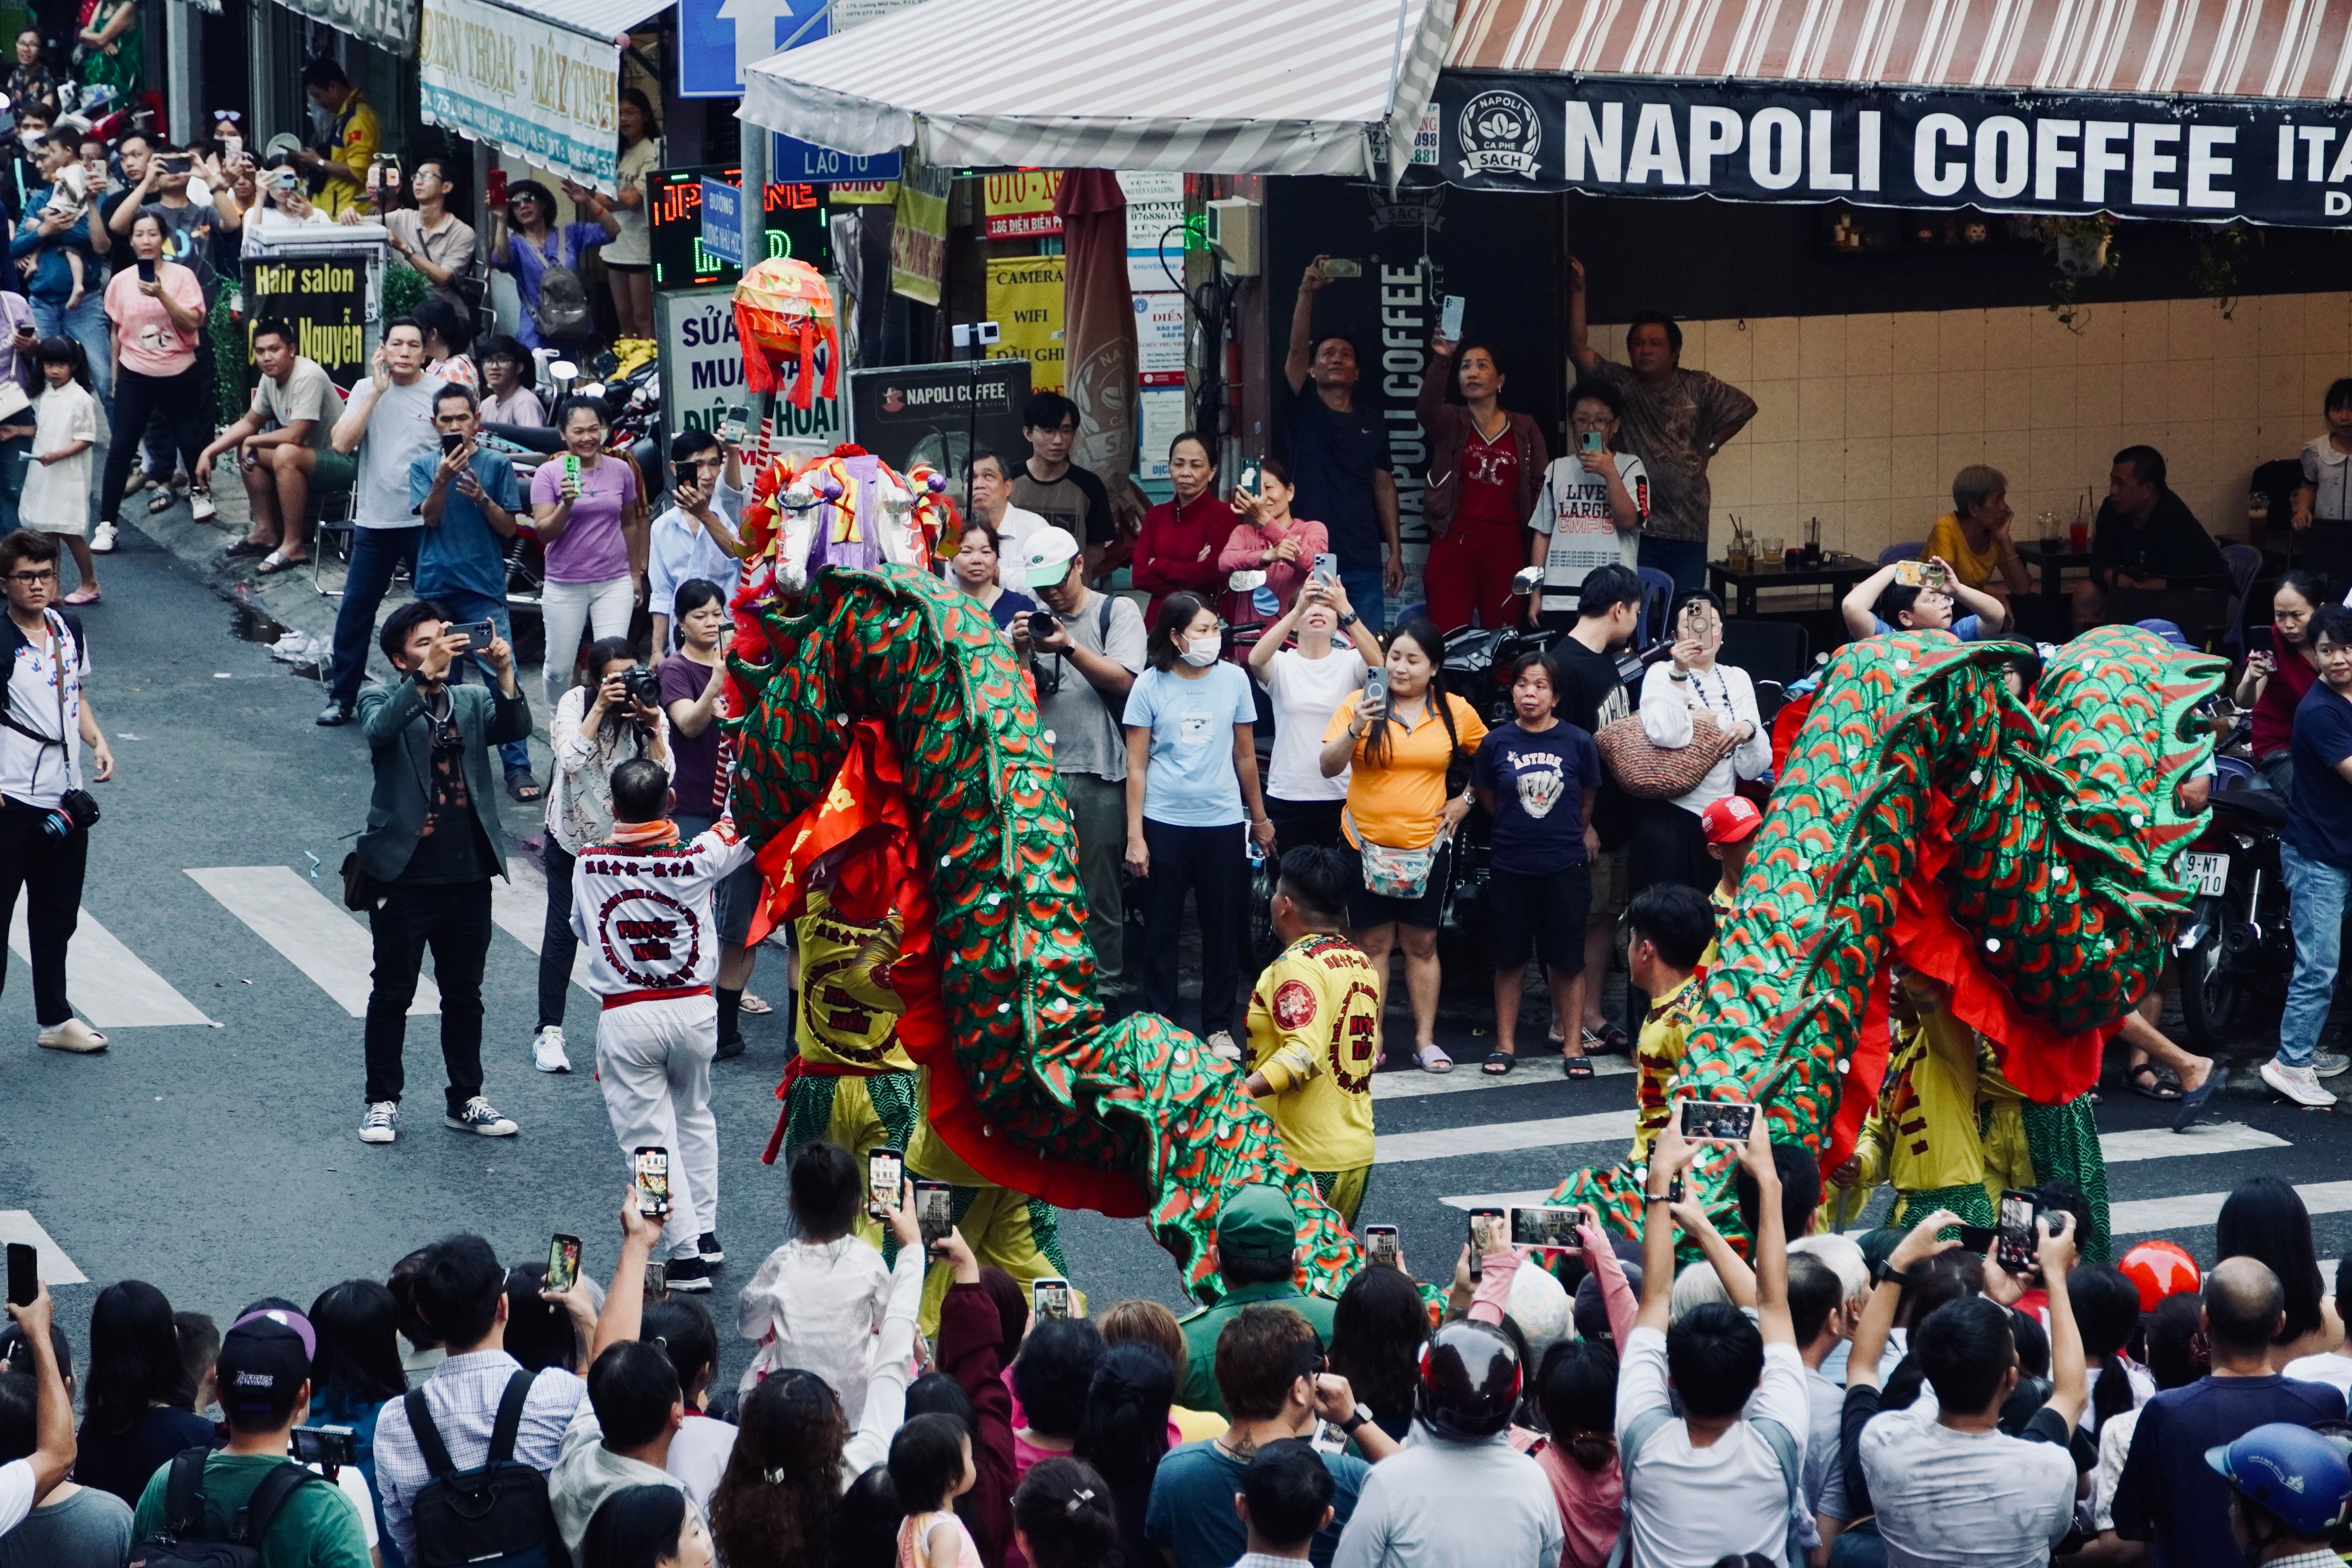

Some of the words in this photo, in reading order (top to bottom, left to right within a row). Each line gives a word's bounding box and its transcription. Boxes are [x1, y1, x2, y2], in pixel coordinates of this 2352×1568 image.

[1479, 96, 1522, 110] NAPOLI
[1484, 141, 1496, 149] CA
[1498, 141, 1516, 150] PHE
[1565, 100, 1881, 191] NAPOLI
[1913, 112, 2237, 209] COFFEE
[256, 263, 296, 296] Hair
[300, 262, 354, 294] salon
[996, 269, 1065, 285] CAMERA
[1013, 309, 1048, 324] WIFI
[299, 307, 362, 371] Nguyễn
[1381, 264, 1425, 397] COFFEE
[906, 386, 953, 405] NAPOLI
[1566, 484, 1608, 501] LIVE
[1559, 502, 1611, 519] LARGE
[1513, 752, 1563, 770] ASTROS
[2187, 855, 2218, 874] 9-N1
[233, 1370, 274, 1388] LAKERS
